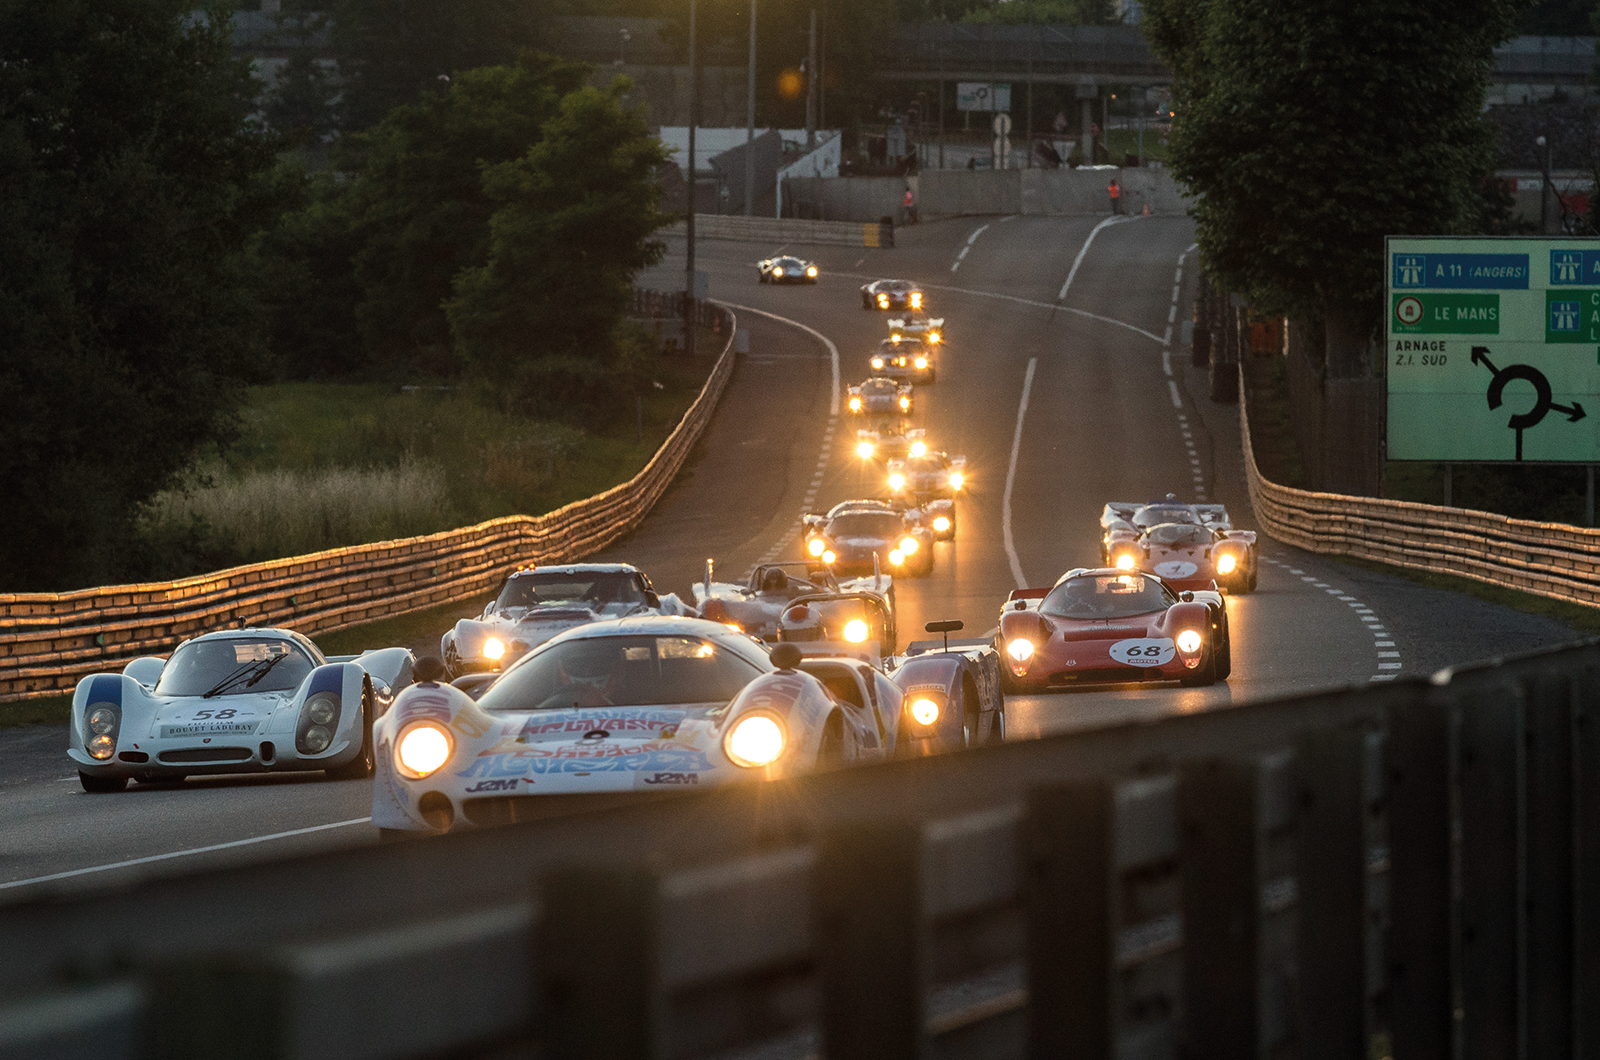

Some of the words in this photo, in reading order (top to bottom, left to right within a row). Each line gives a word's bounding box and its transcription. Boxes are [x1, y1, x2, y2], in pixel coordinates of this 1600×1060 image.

[1436, 264, 1445, 277] A
[1449, 264, 1462, 277] 11
[1469, 266, 1526, 278] (ANGERS)
[1435, 307, 1450, 320] LE
[1457, 307, 1497, 320] MANS
[1395, 340, 1446, 351] ARNAGE
[1395, 354, 1415, 365] Z.I.
[1422, 354, 1447, 365] SUD
[1126, 646, 1161, 657] 68
[192, 709, 238, 720] 58
[169, 726, 205, 734] BOUVET
[644, 772, 698, 785] J2M
[465, 778, 519, 793] J2M
